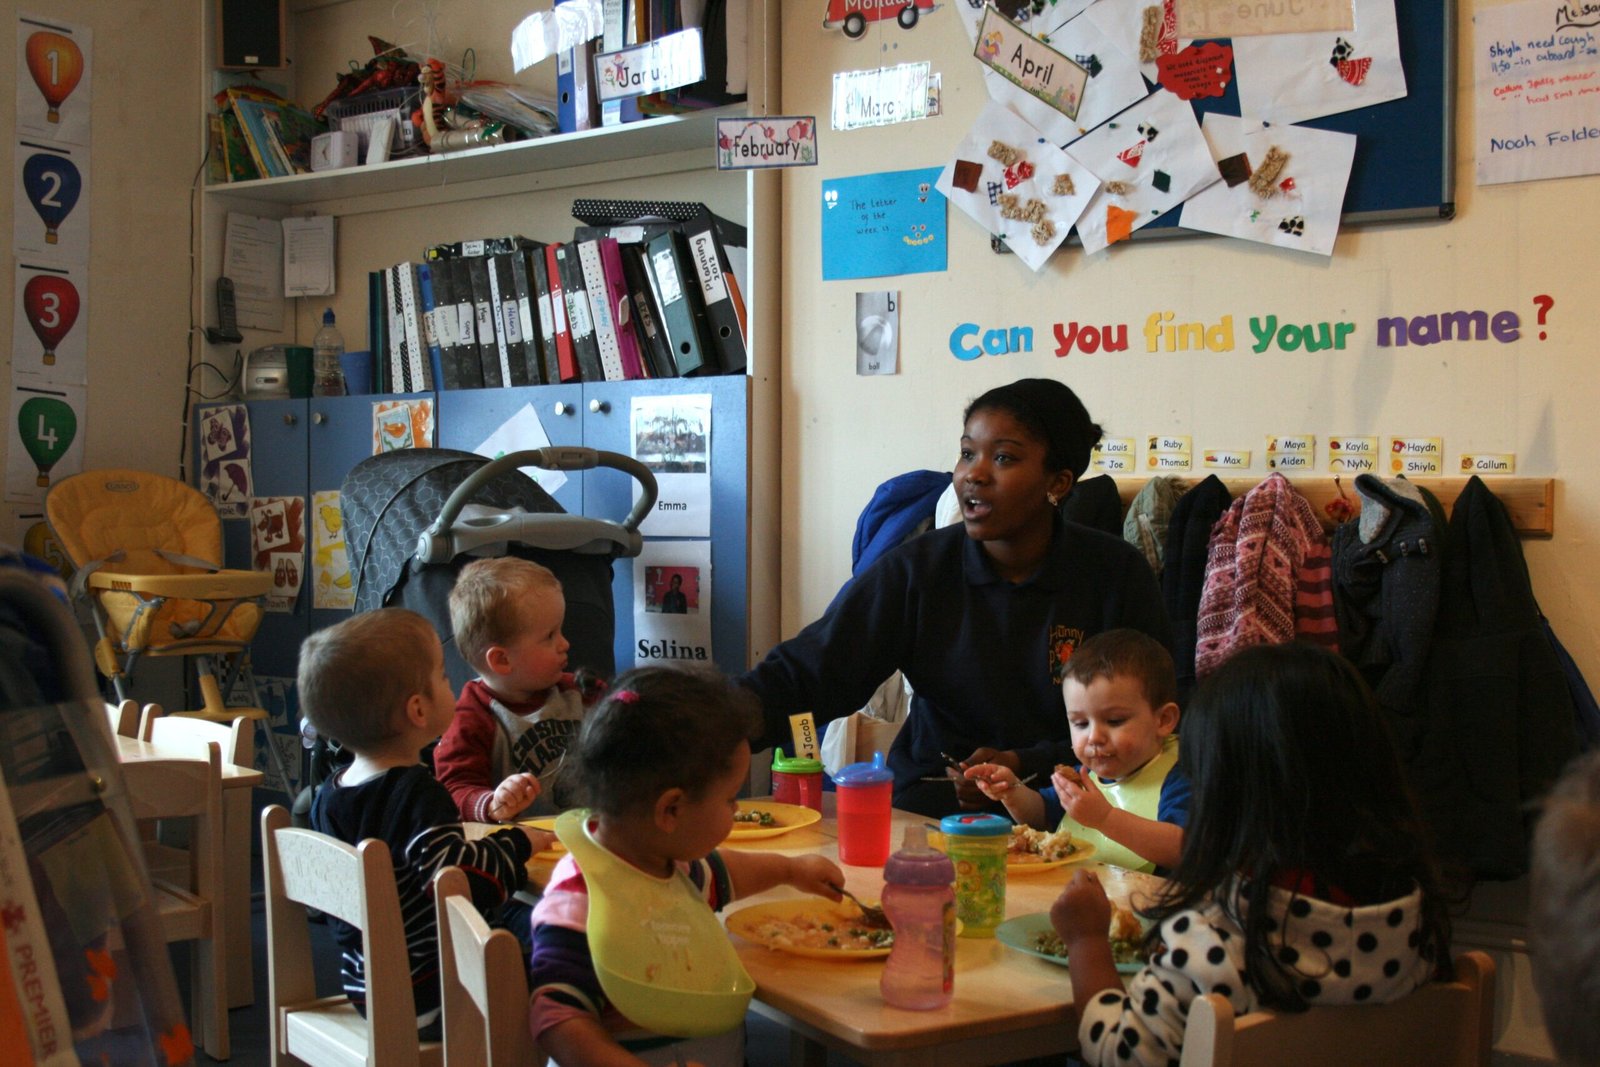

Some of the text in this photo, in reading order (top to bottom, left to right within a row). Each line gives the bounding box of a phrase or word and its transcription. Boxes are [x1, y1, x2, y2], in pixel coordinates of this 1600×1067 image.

[1527, 35, 1554, 49] need
[1559, 32, 1595, 48] cough
[47, 51, 58, 85] 1
[1011, 43, 1054, 85] April
[861, 96, 896, 118] Marc
[1491, 127, 1600, 153] Noah Folde
[41, 171, 62, 207] 2
[851, 200, 866, 210] The
[861, 212, 886, 225] of the
[695, 237, 713, 292] Planning
[708, 256, 720, 281] 2012
[40, 293, 60, 328] 3
[887, 292, 896, 312] b
[508, 307, 516, 336] Helena
[949, 322, 1034, 362] Can
[1053, 320, 1128, 358] you
[1143, 311, 1234, 353] find
[1249, 313, 1355, 354] your
[1376, 305, 1521, 348] name
[38, 413, 58, 450] 4
[1107, 443, 1128, 452] Louis
[1163, 440, 1183, 450] Ruby
[1284, 440, 1307, 450] Maya
[1345, 441, 1369, 451] Kayla
[1407, 443, 1437, 453] Haydn
[1108, 460, 1123, 469] Joe
[1160, 458, 1189, 467] Thomas
[1223, 457, 1241, 465] Max
[1281, 457, 1306, 466] Aiden
[1347, 458, 1373, 470] NyNy
[1407, 462, 1436, 473] Shiyla
[1476, 460, 1508, 470] Callum
[658, 500, 688, 512] Emma
[44, 539, 64, 568] 5
[637, 639, 708, 661] Selina
[799, 718, 813, 750] Jacob
[520, 736, 569, 778] LASS
[14, 945, 58, 1063] PREMIER
